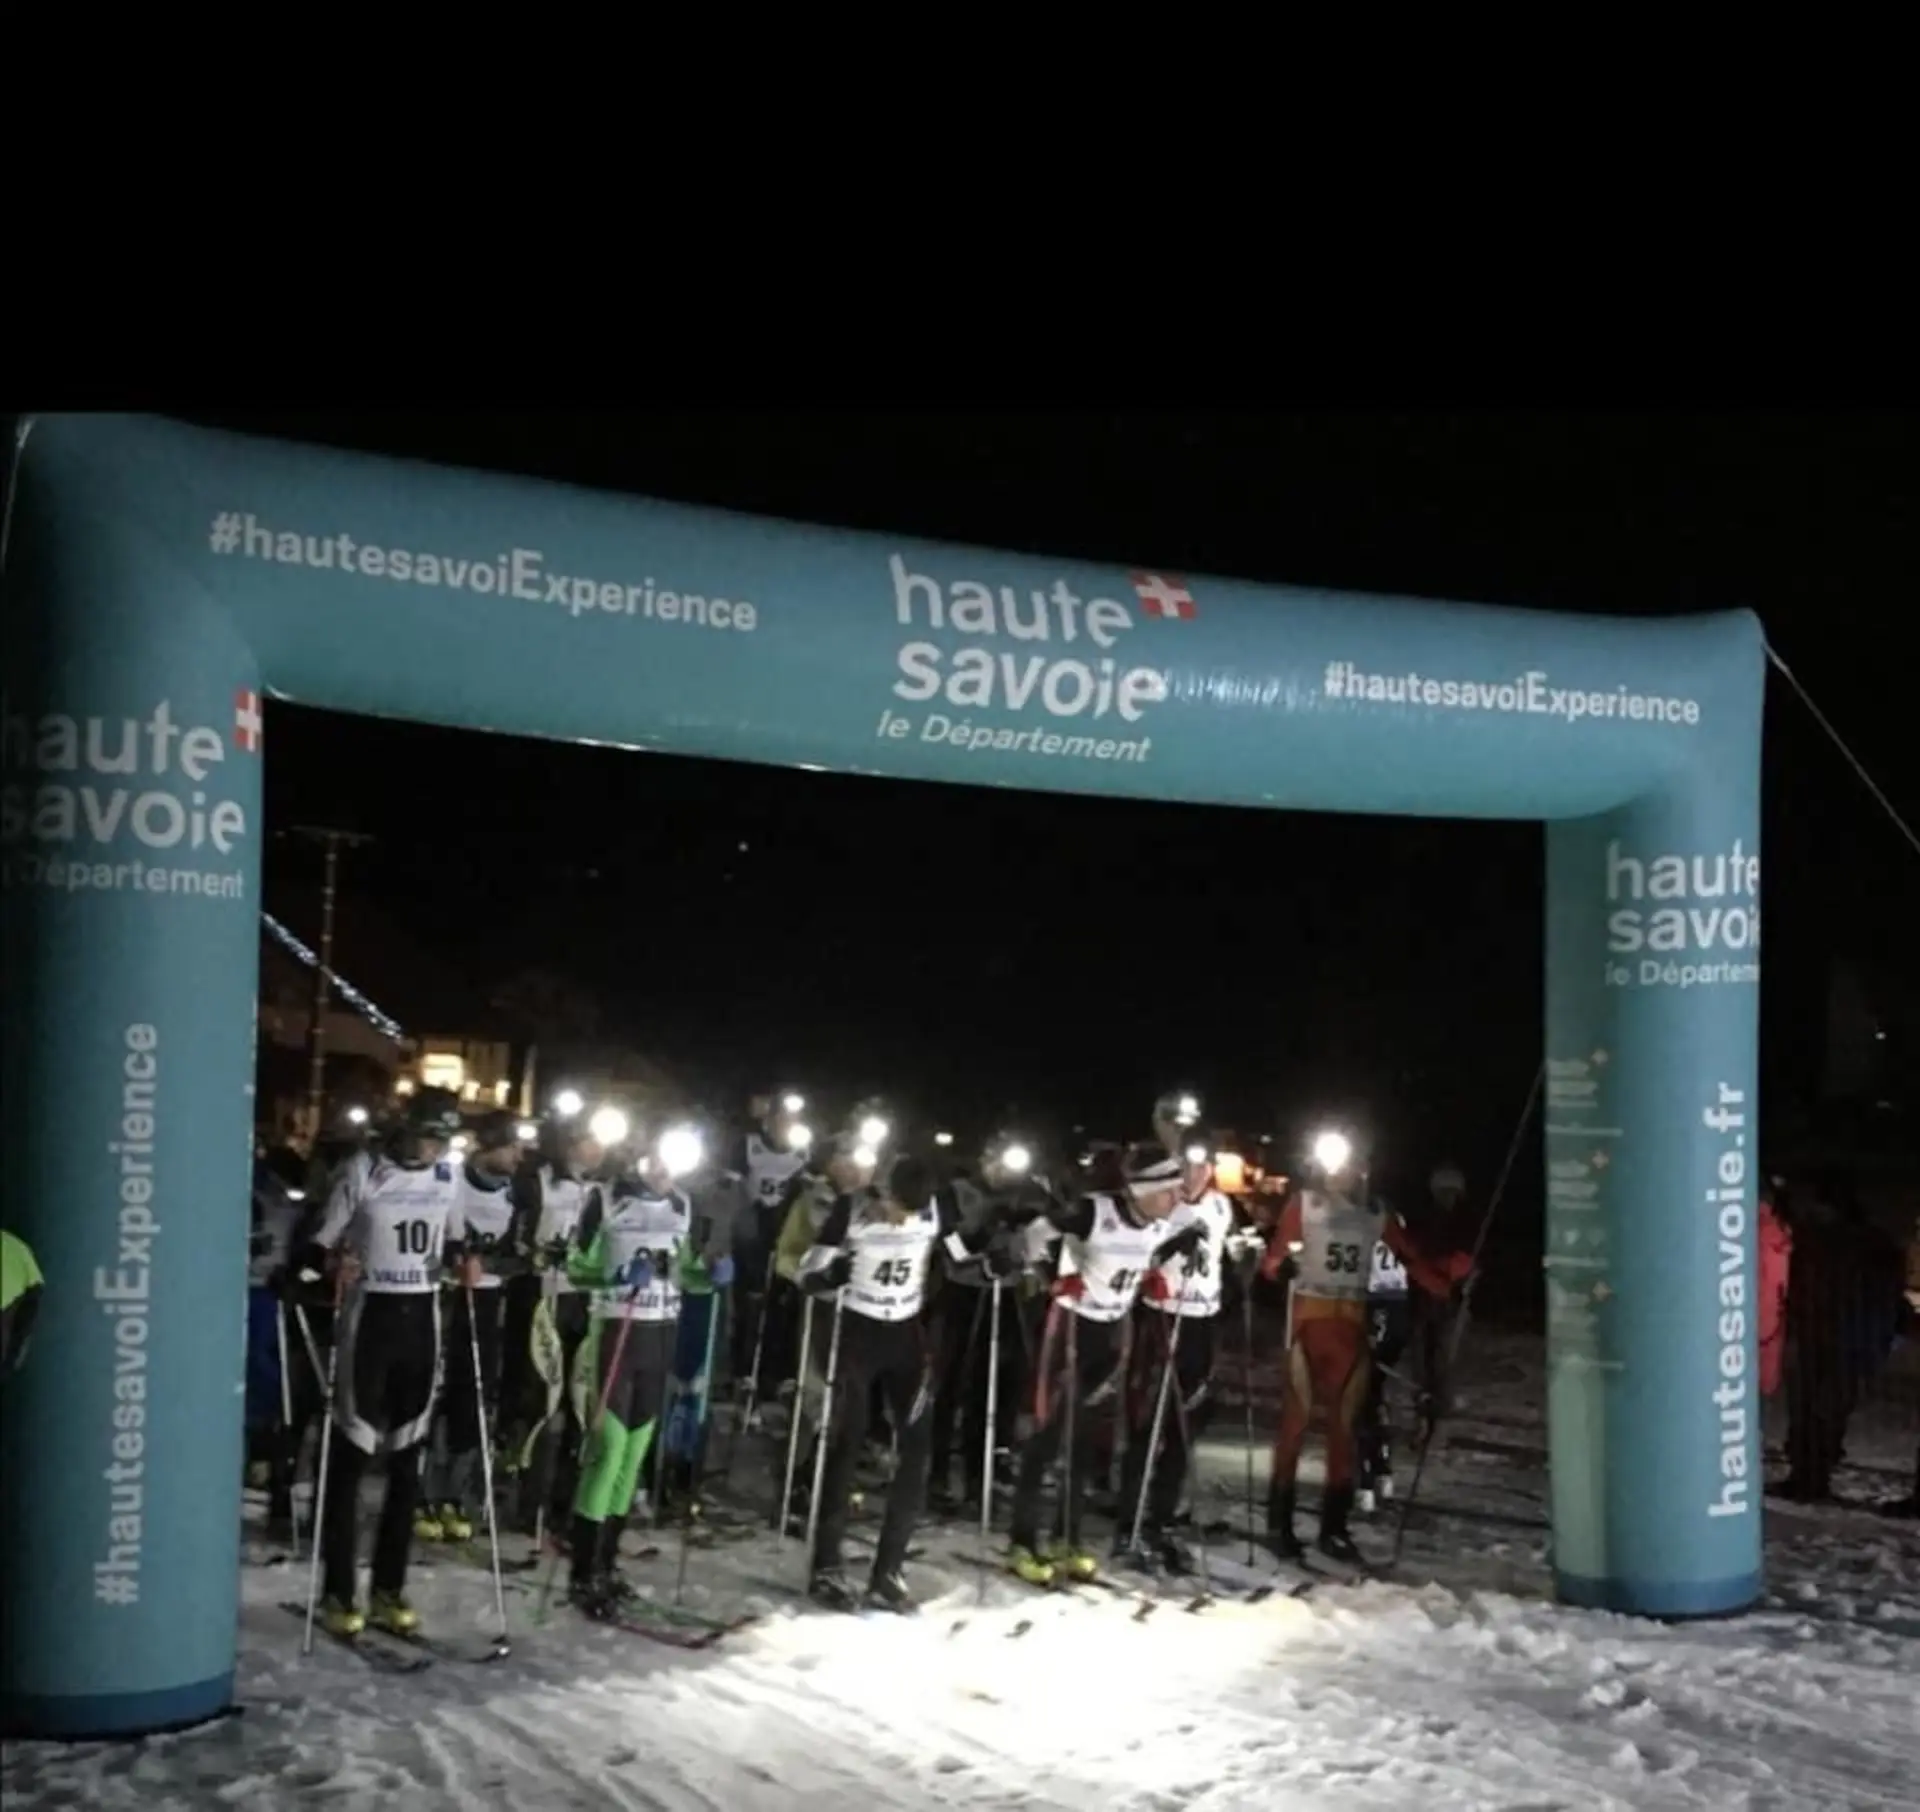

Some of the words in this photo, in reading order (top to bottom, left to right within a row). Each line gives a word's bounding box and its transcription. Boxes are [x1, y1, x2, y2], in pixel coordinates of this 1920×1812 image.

[208, 510, 758, 633] #hautesavoiExperience
[889, 553, 1134, 648] haute
[893, 640, 1168, 722] savoie
[1323, 660, 1699, 725] #hautesavoiExperience
[876, 709, 911, 739] le
[920, 714, 1152, 763] Département
[1606, 838, 1759, 899] haute
[1607, 903, 1760, 953] savoi
[392, 1219, 430, 1255] 10
[1325, 1243, 1361, 1273] 53
[872, 1258, 913, 1287] 45
[1703, 1081, 1748, 1518] hautesavoie.fr
[94, 1021, 161, 1605] #hautesavoiExperience
